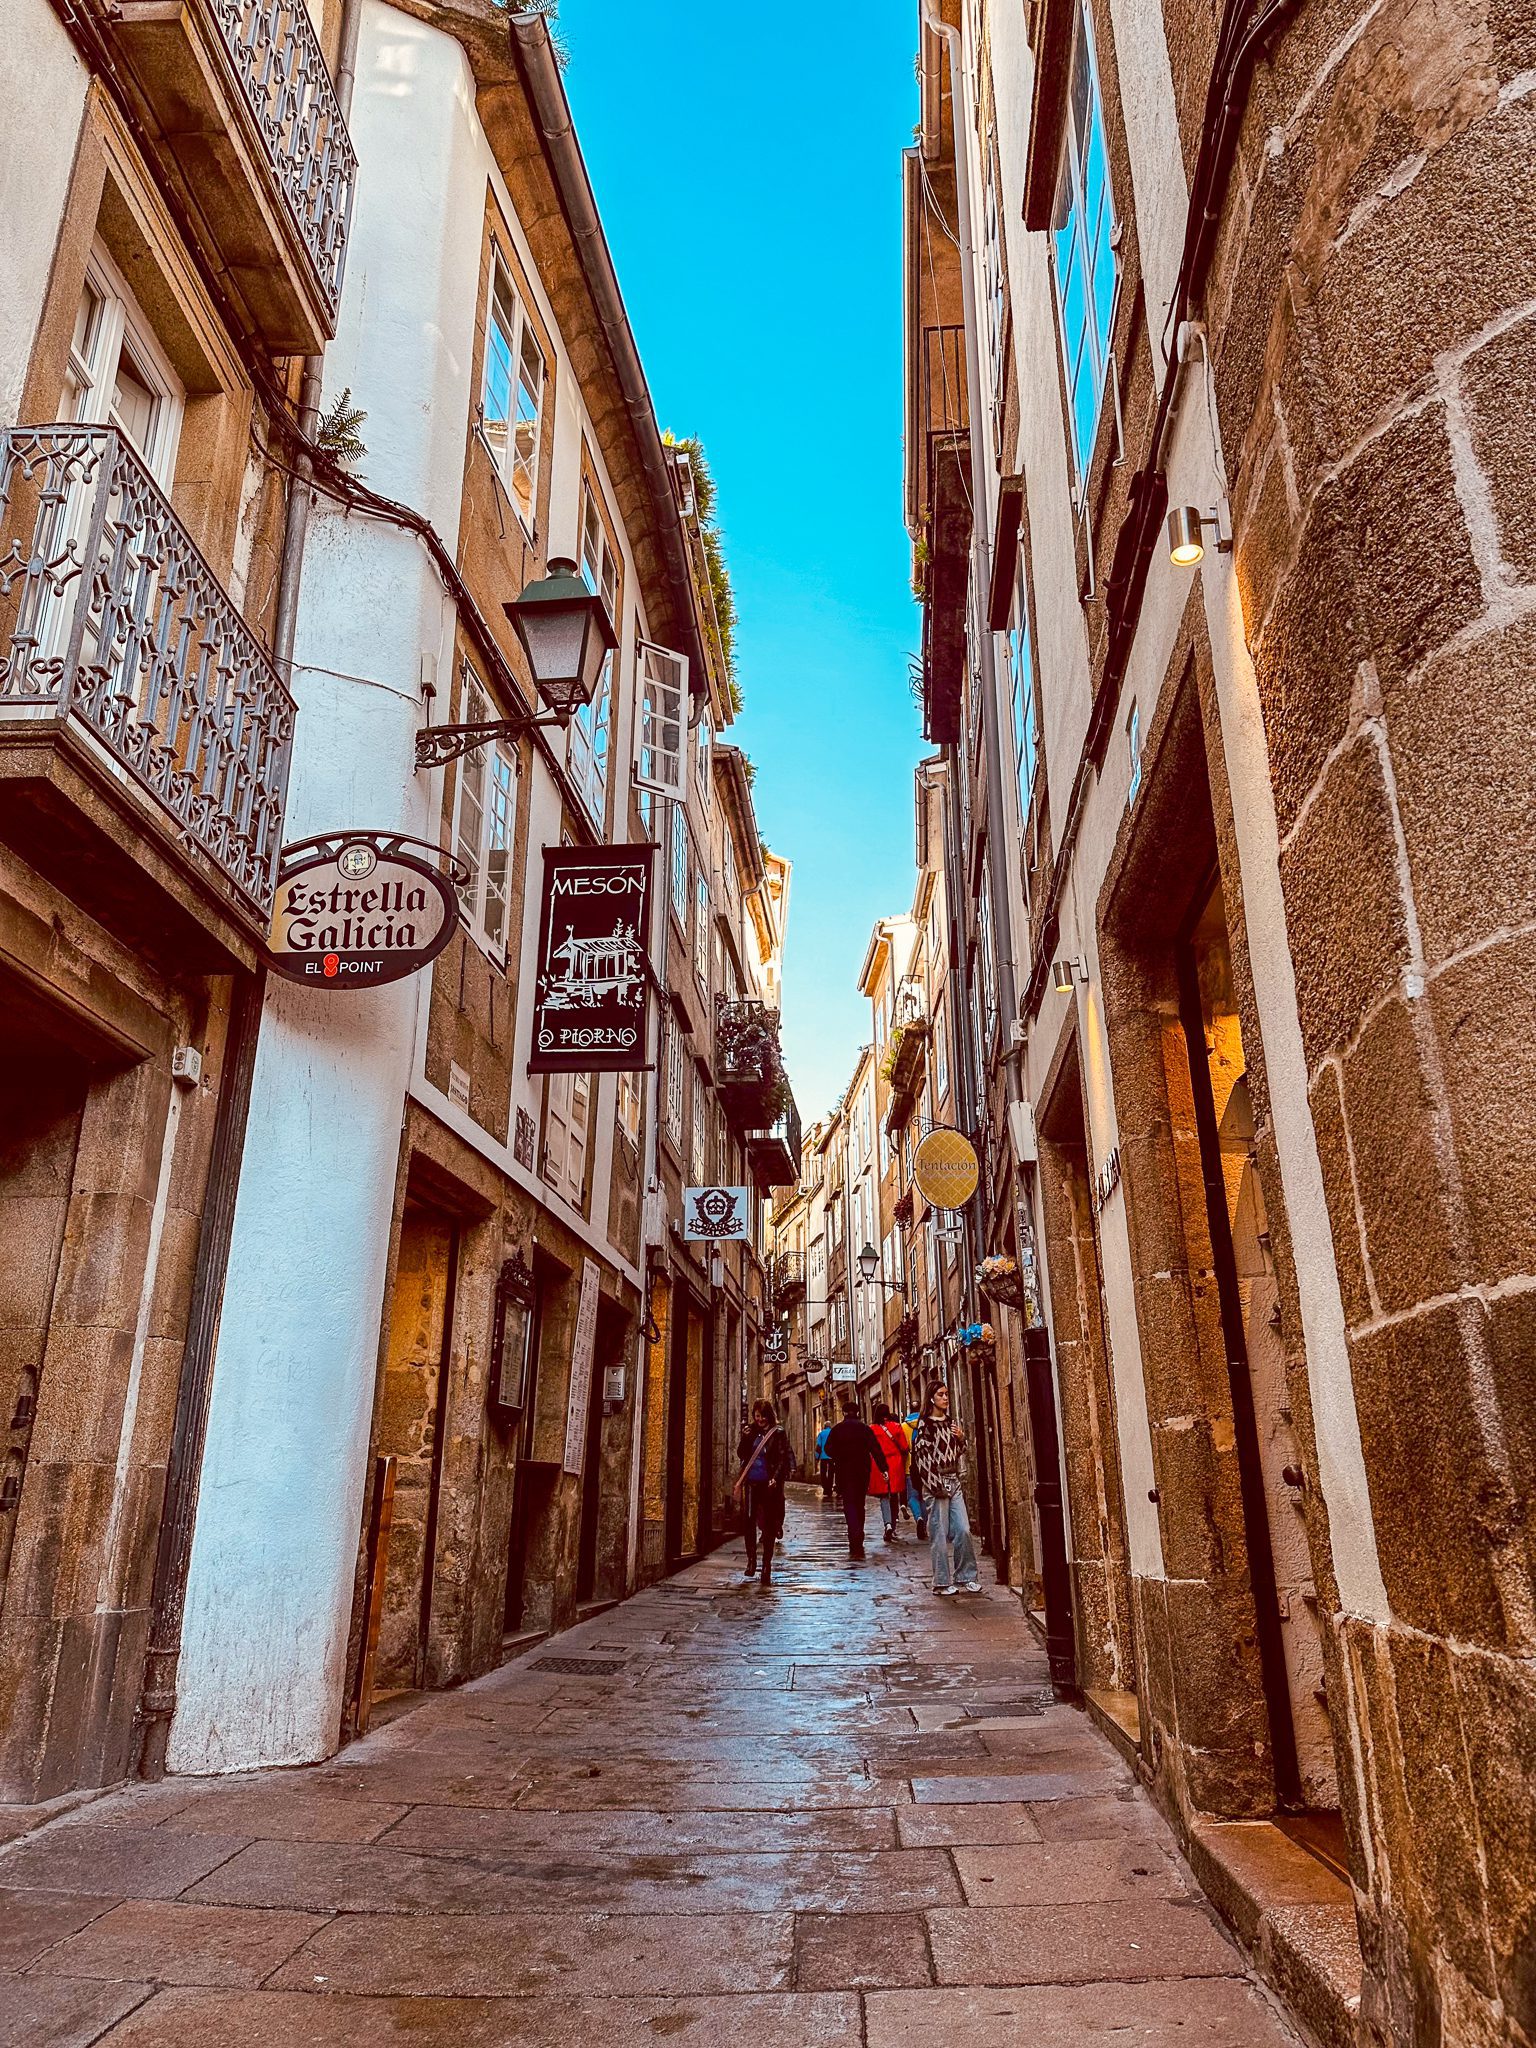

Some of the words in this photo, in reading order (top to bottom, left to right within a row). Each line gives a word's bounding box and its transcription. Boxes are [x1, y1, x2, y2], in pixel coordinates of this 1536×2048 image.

[550, 869, 647, 895] MESÓN
[281, 881, 427, 916] Estrella
[287, 915, 416, 951] Galicia
[305, 962, 322, 974] EL
[339, 960, 384, 974] POINT
[538, 1029, 554, 1047] O
[560, 1028, 637, 1047] PIORNO
[917, 1158, 976, 1171] Tentación
